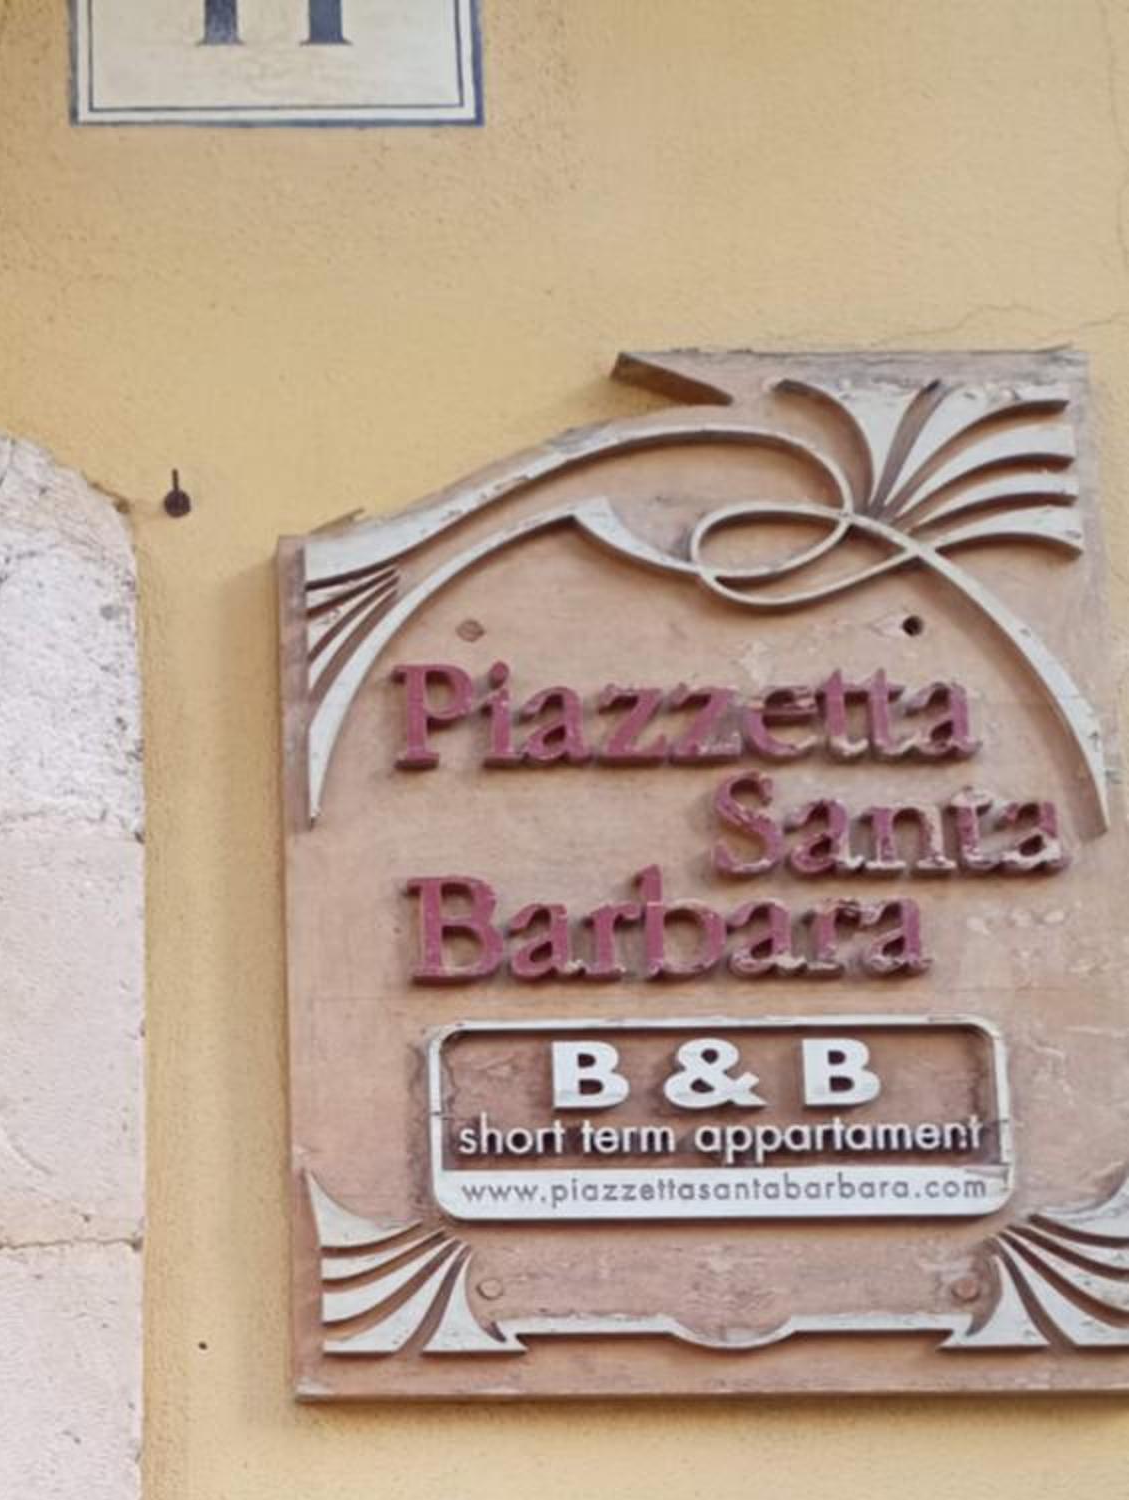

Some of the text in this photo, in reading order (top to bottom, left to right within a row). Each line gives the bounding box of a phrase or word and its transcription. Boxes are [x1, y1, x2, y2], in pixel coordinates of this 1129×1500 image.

[394, 661, 978, 768] Piazzetta
[712, 770, 1070, 876] Santa
[405, 865, 931, 984] Barbara
[551, 1037, 881, 1110] B & B
[458, 1112, 983, 1165] short term appartament
[461, 1172, 987, 1208] www.piazzettasantabarbara.com
